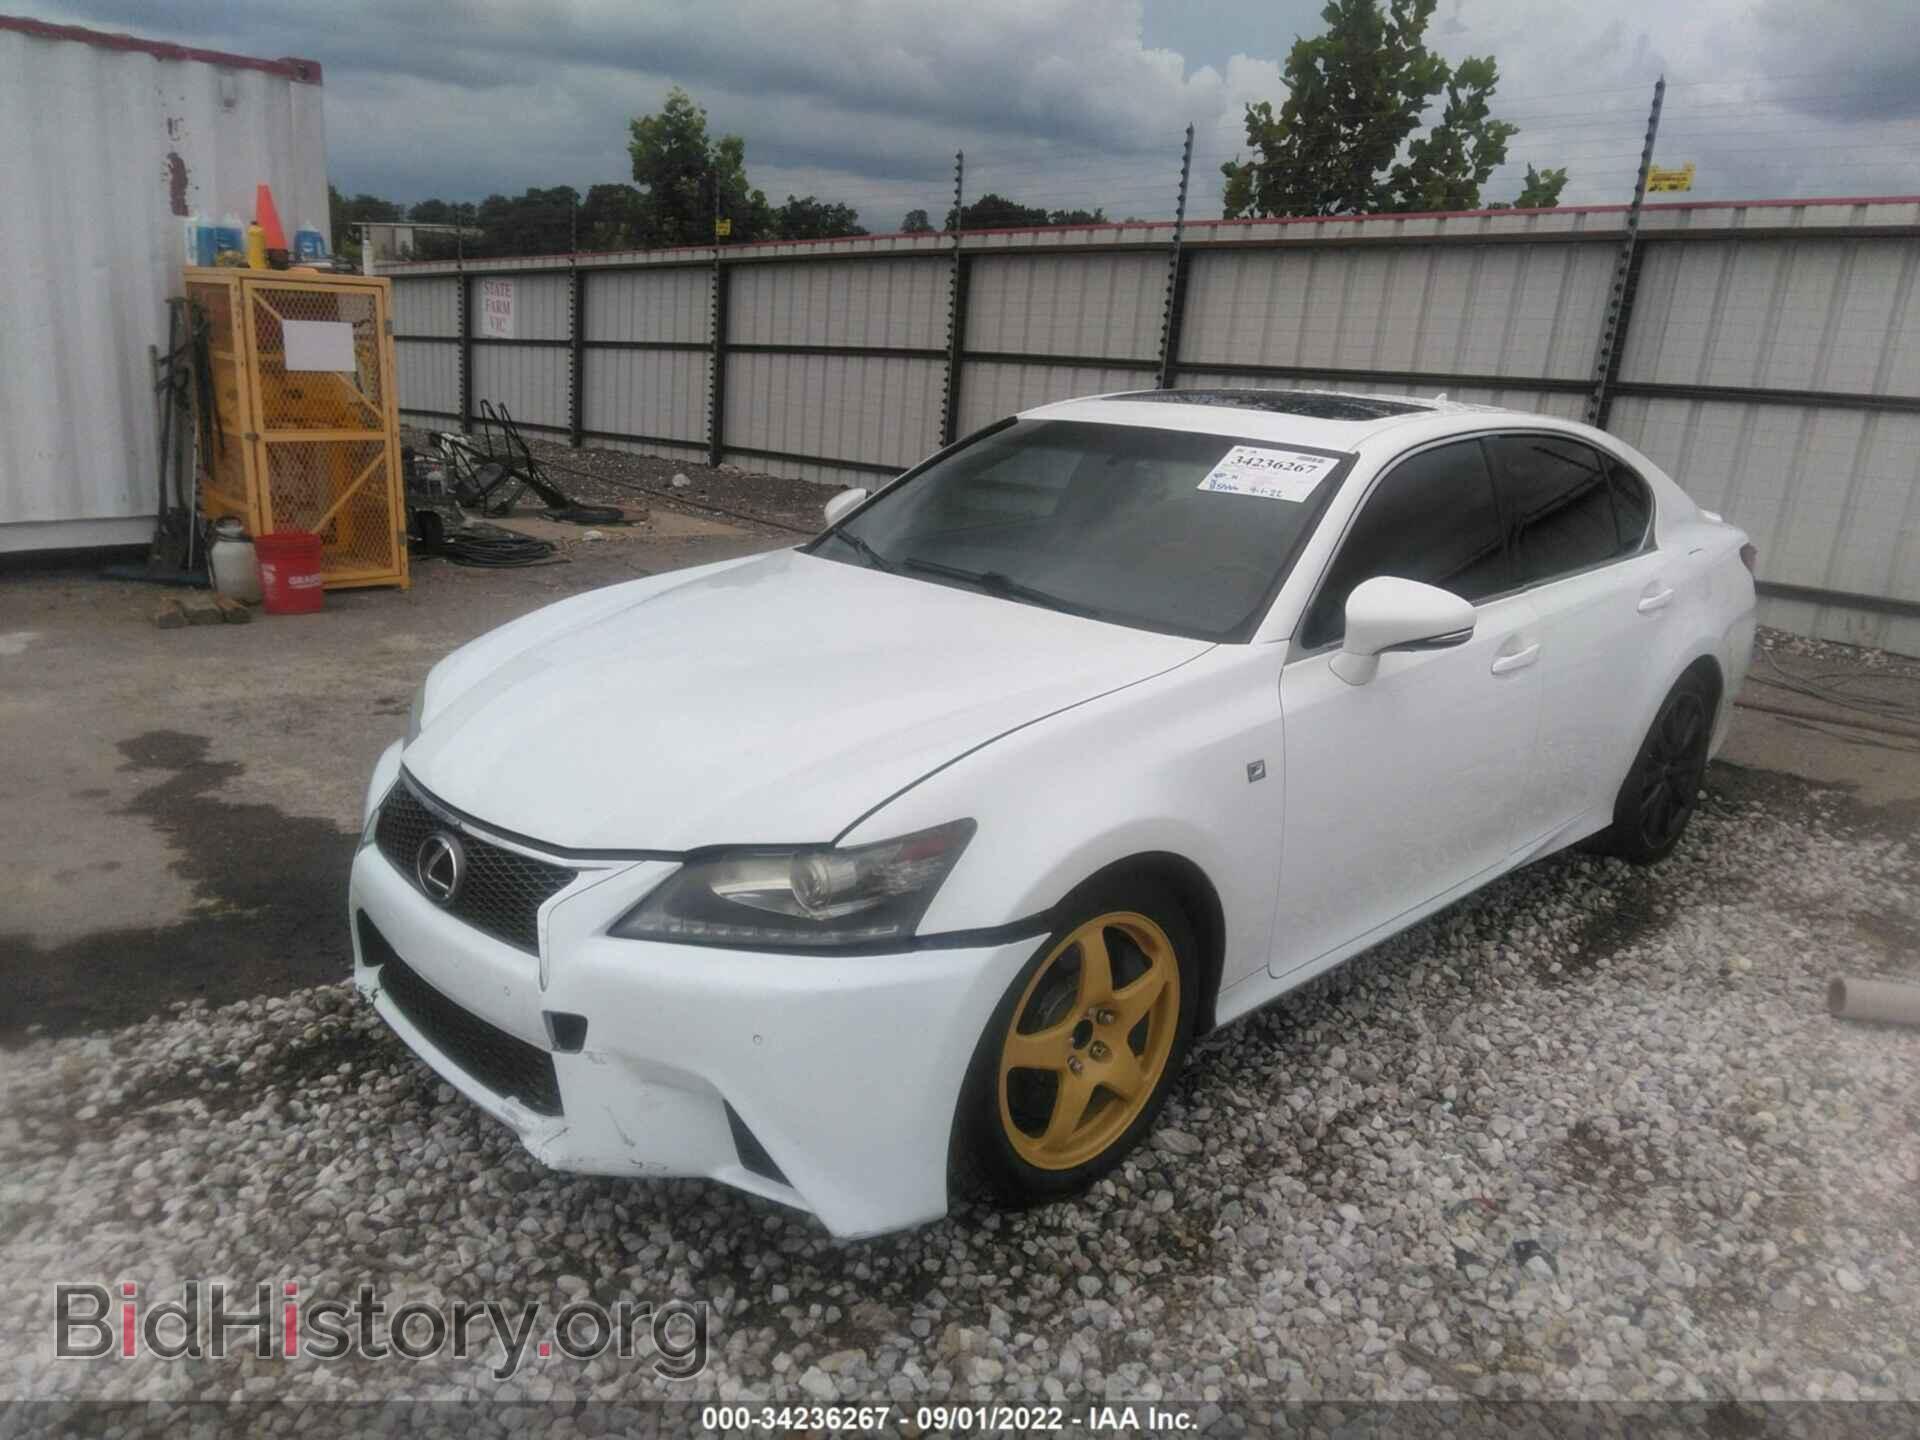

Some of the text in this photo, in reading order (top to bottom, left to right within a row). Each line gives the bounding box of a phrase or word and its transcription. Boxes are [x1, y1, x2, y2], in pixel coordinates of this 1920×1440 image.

[482, 280, 512, 297] STATE
[485, 298, 511, 315] FARM
[1230, 455, 1318, 474] 34236267
